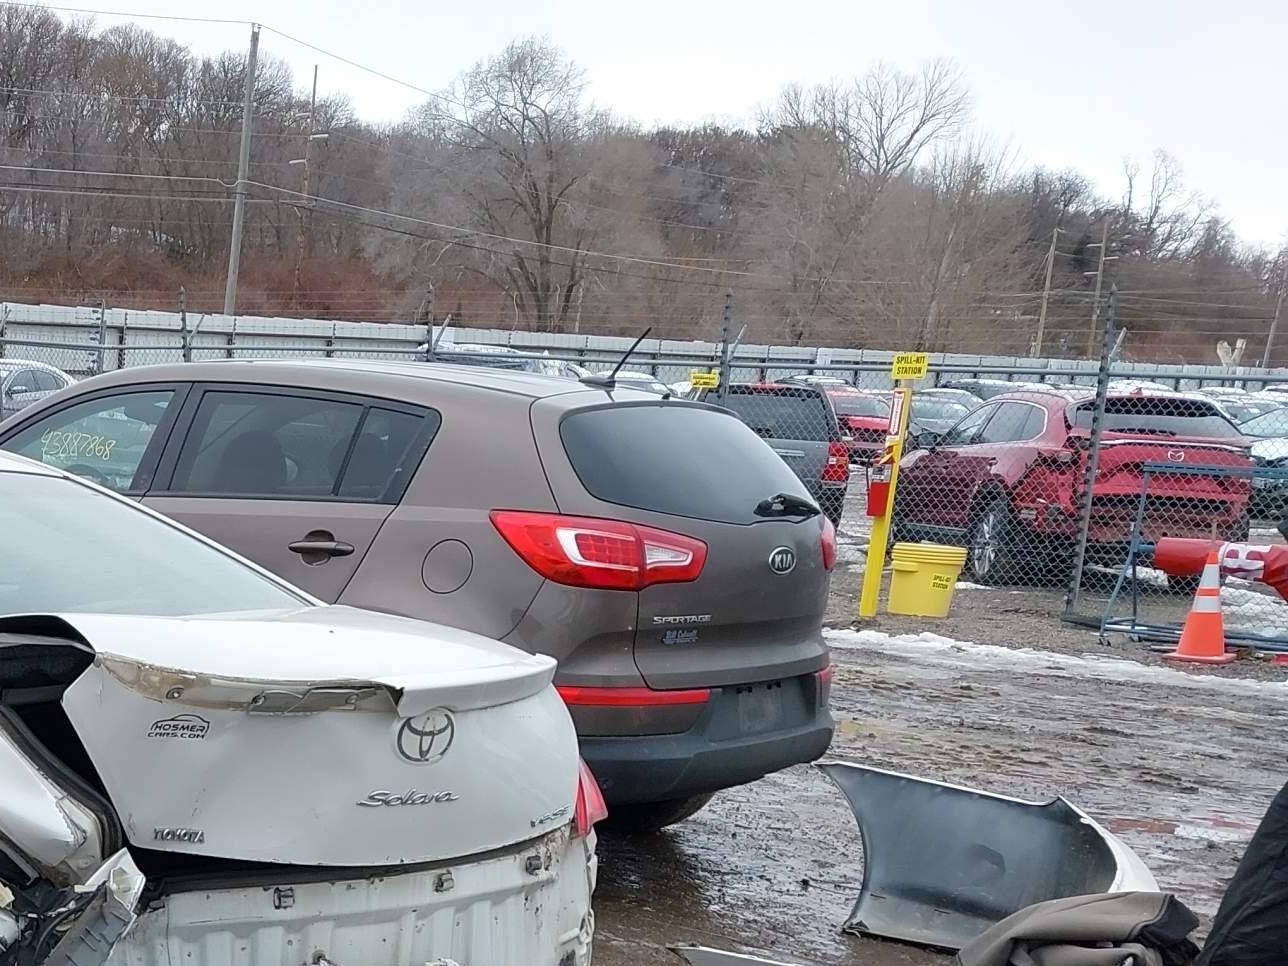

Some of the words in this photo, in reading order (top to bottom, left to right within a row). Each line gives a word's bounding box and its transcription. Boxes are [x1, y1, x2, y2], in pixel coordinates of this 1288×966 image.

[896, 356, 926, 365] SPILL-KIT
[896, 366, 922, 375] STATION
[774, 553, 793, 569] KIA
[653, 614, 712, 625] SPORTAGE
[154, 723, 206, 733] HOSMER
[147, 731, 206, 739] CARS.COM
[356, 787, 460, 807] Solara
[153, 827, 205, 844] TOYOTA
